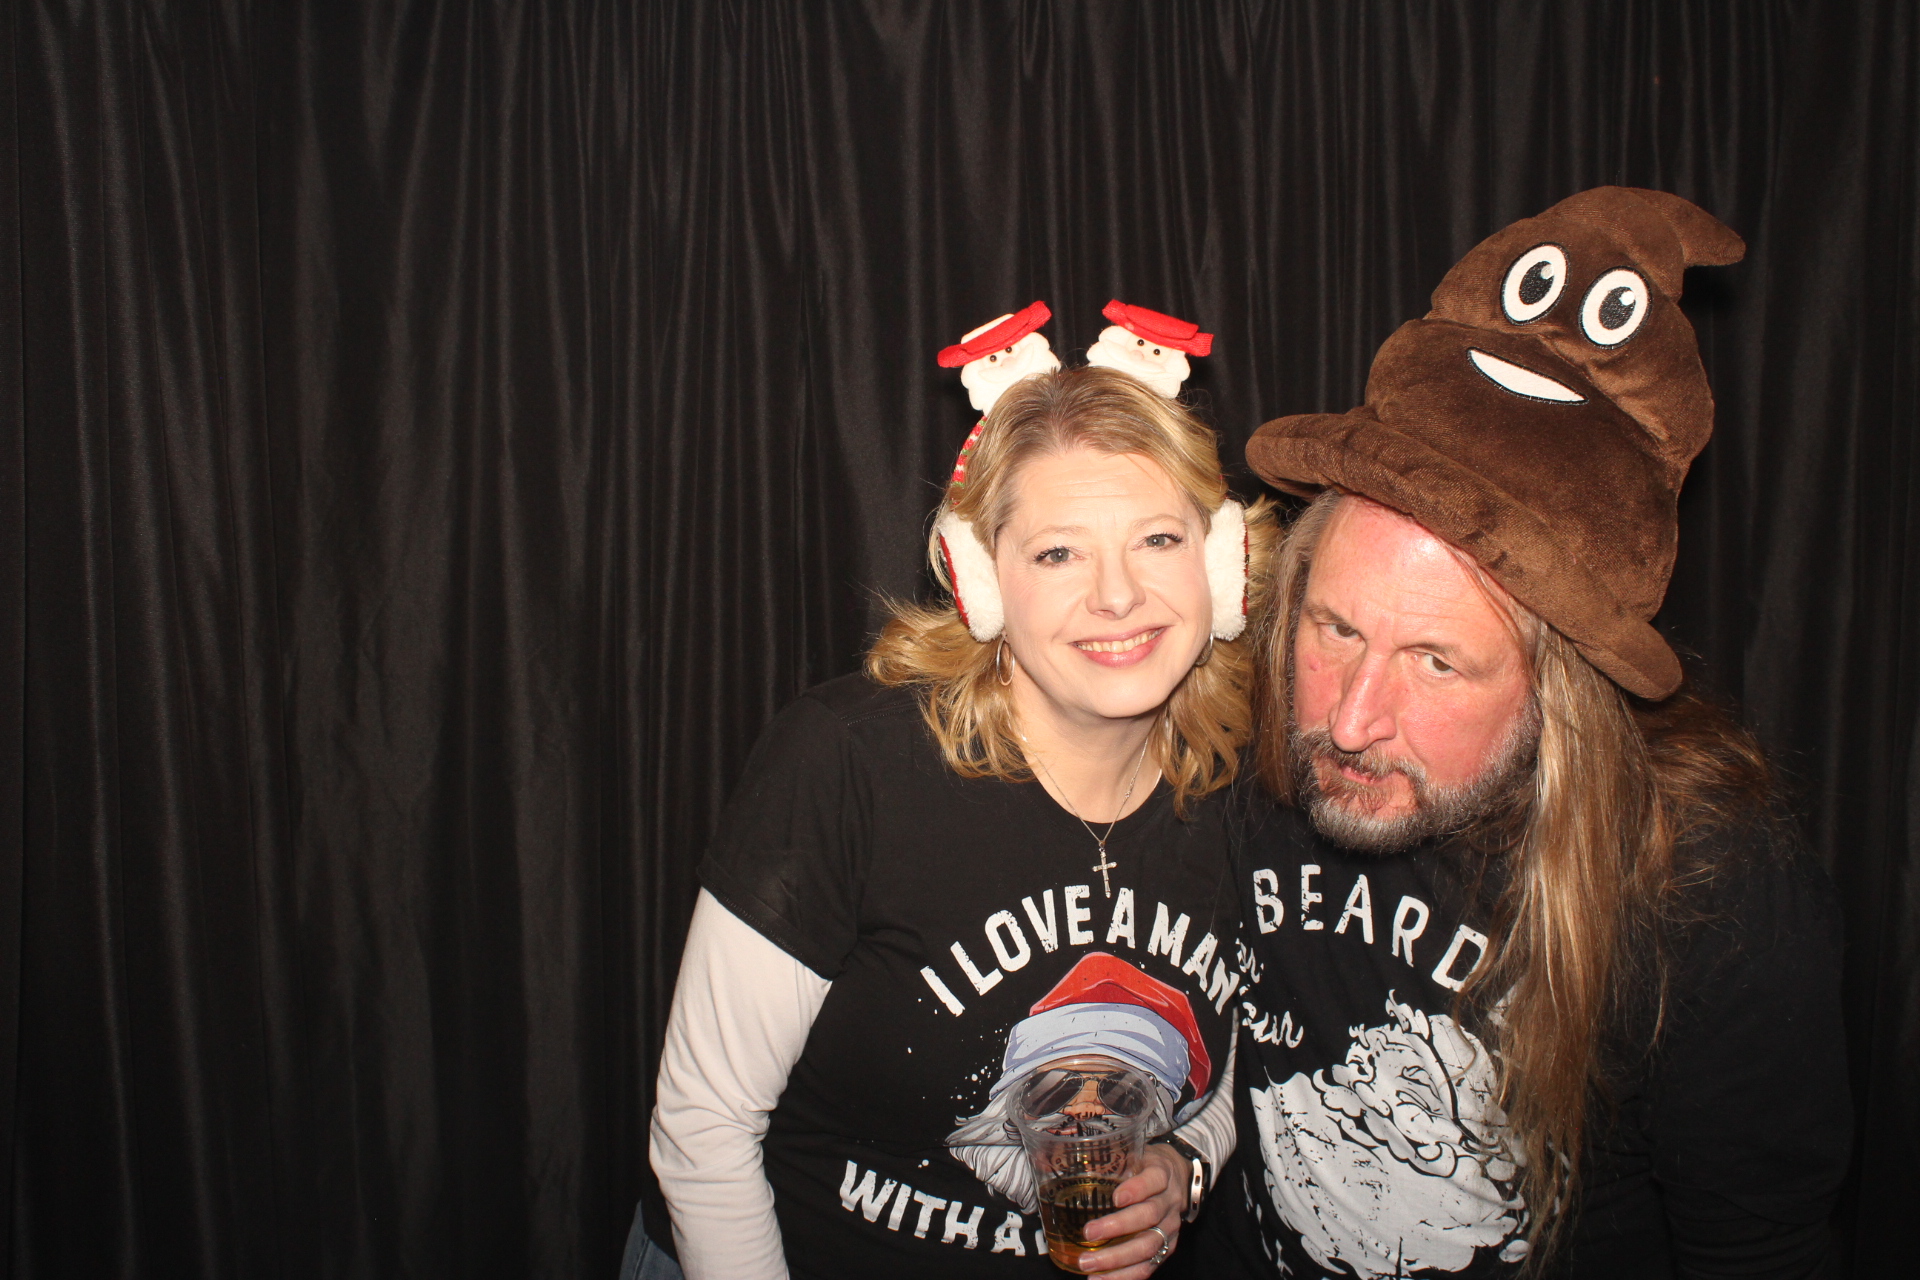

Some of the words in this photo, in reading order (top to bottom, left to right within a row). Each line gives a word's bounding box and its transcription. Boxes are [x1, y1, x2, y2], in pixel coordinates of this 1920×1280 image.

[919, 966, 966, 1018] I
[950, 885, 1095, 996] LOVE
[1106, 887, 1137, 950] A
[1147, 901, 1240, 1016] MAN
[1252, 863, 1491, 993] BEARD
[839, 1160, 985, 1250] WITH
[990, 1211, 1026, 1257] A
